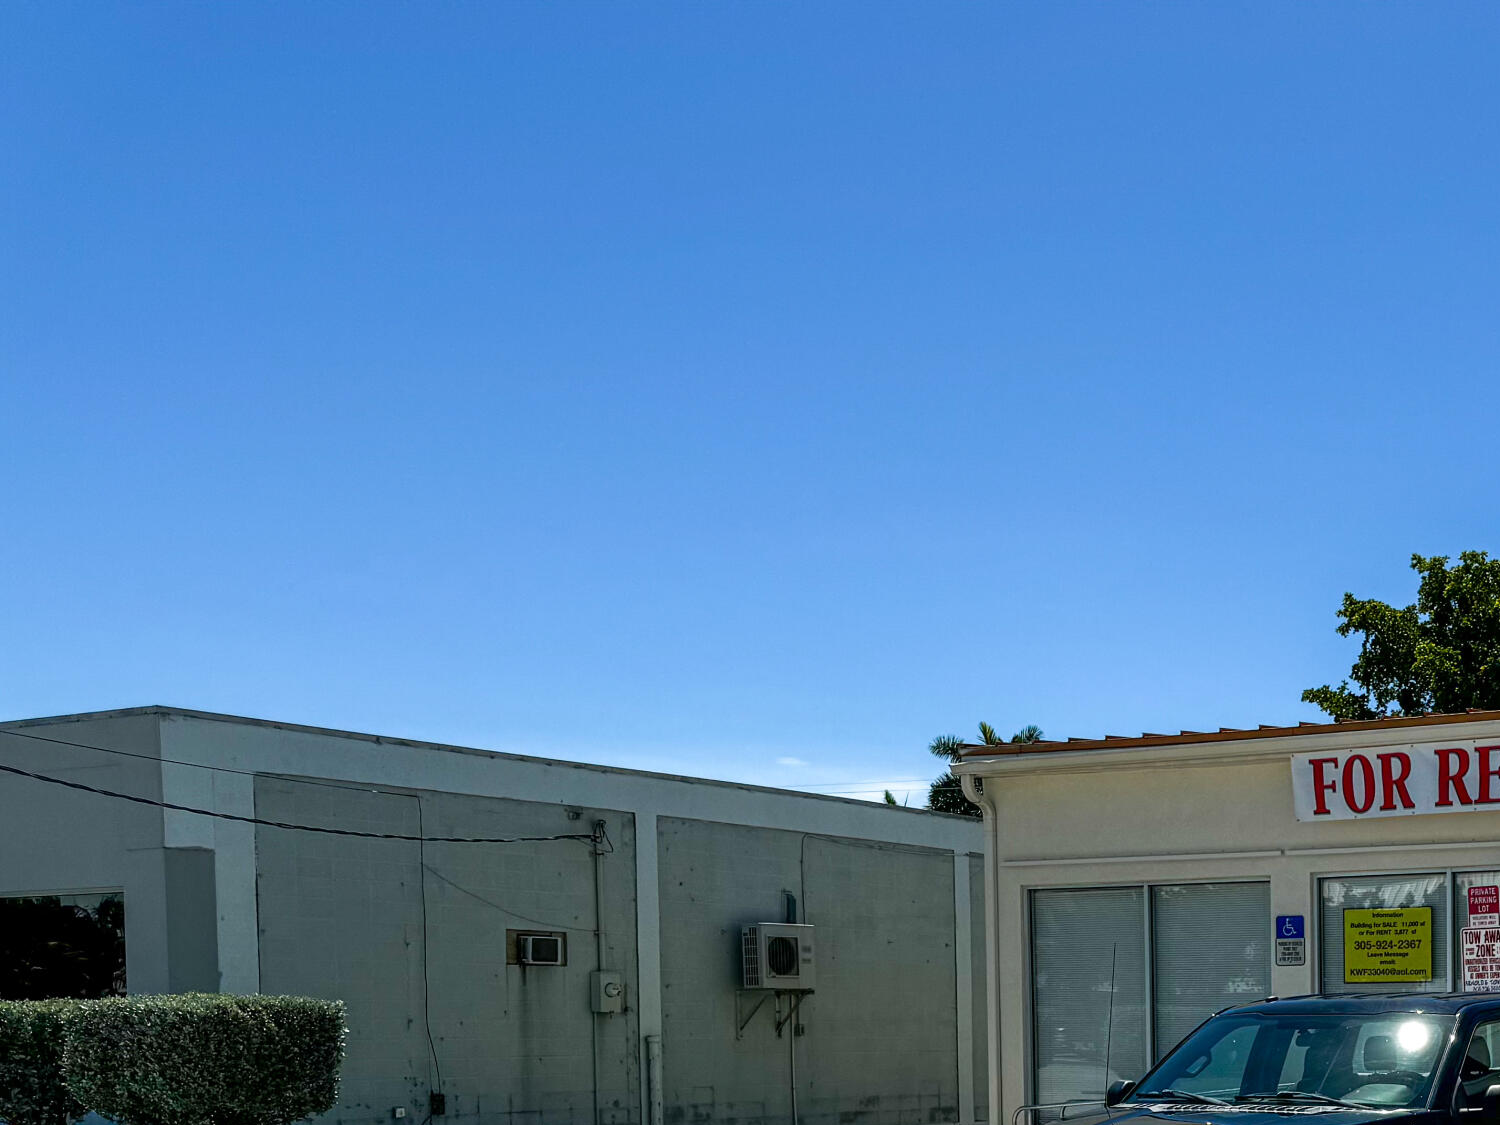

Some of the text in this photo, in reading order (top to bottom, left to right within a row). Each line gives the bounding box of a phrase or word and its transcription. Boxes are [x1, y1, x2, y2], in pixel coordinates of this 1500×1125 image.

[1308, 751, 1415, 815] FOR
[1470, 888, 1496, 896] PRIVATE
[1470, 896, 1497, 904] PARKING
[1478, 904, 1489, 913] LOT
[1464, 931, 1481, 944] TOW
[1354, 940, 1422, 950] 305-924-2367
[1476, 944, 1496, 957] ZONE
